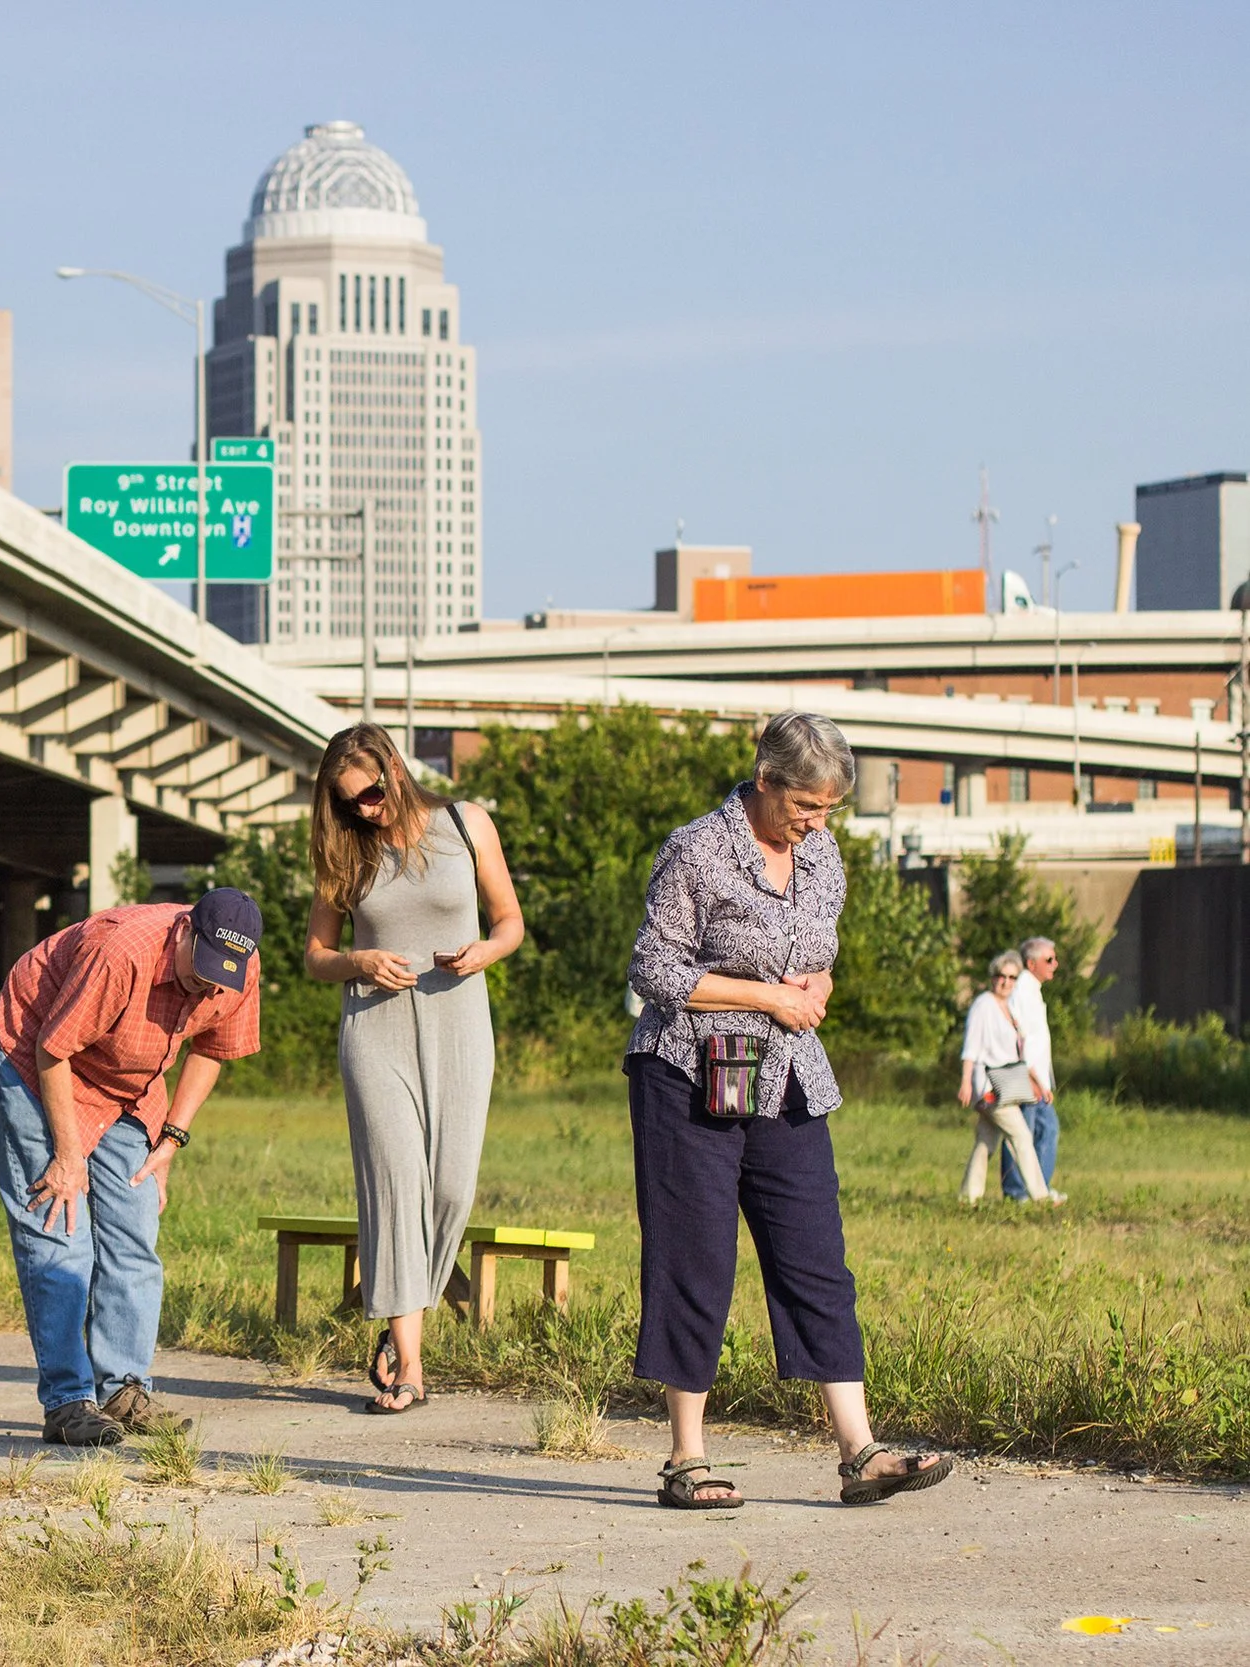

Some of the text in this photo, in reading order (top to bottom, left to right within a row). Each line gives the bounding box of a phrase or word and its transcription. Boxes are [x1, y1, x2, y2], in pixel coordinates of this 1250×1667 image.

[256, 444, 268, 458] 4
[80, 497, 119, 518] Roy
[221, 498, 260, 515] Ave
